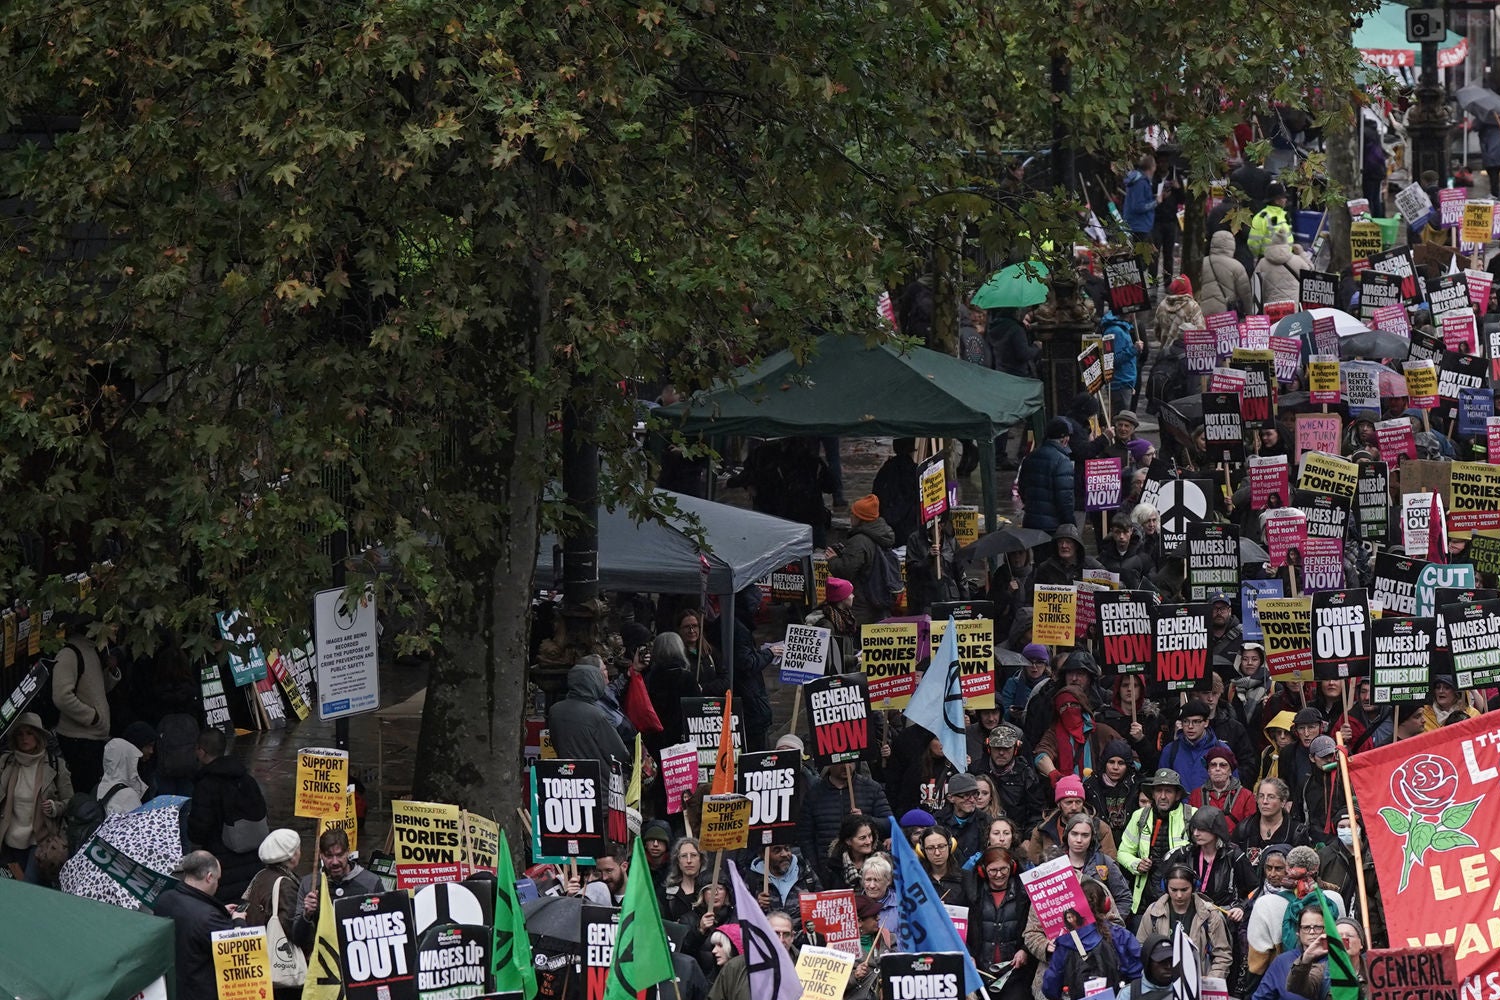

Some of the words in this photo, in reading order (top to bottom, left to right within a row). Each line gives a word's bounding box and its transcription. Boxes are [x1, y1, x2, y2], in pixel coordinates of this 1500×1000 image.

[790, 627, 818, 637] FREEZE
[336, 641, 359, 650] RECORDED
[789, 636, 813, 645] RENTS
[343, 647, 364, 655] PURPOSE
[787, 644, 819, 654] SERVICE
[336, 654, 364, 664] PREVENTION
[786, 652, 822, 663] CHARGES
[785, 660, 805, 669] NOW
[816, 897, 852, 909] GENERAL
[812, 908, 840, 918] STRIKE
[843, 905, 853, 913] TO
[825, 913, 855, 925] TOPPLE
[841, 921, 856, 930] THE
[826, 930, 857, 940] TORIES!
[1369, 953, 1452, 989] GENERAL
